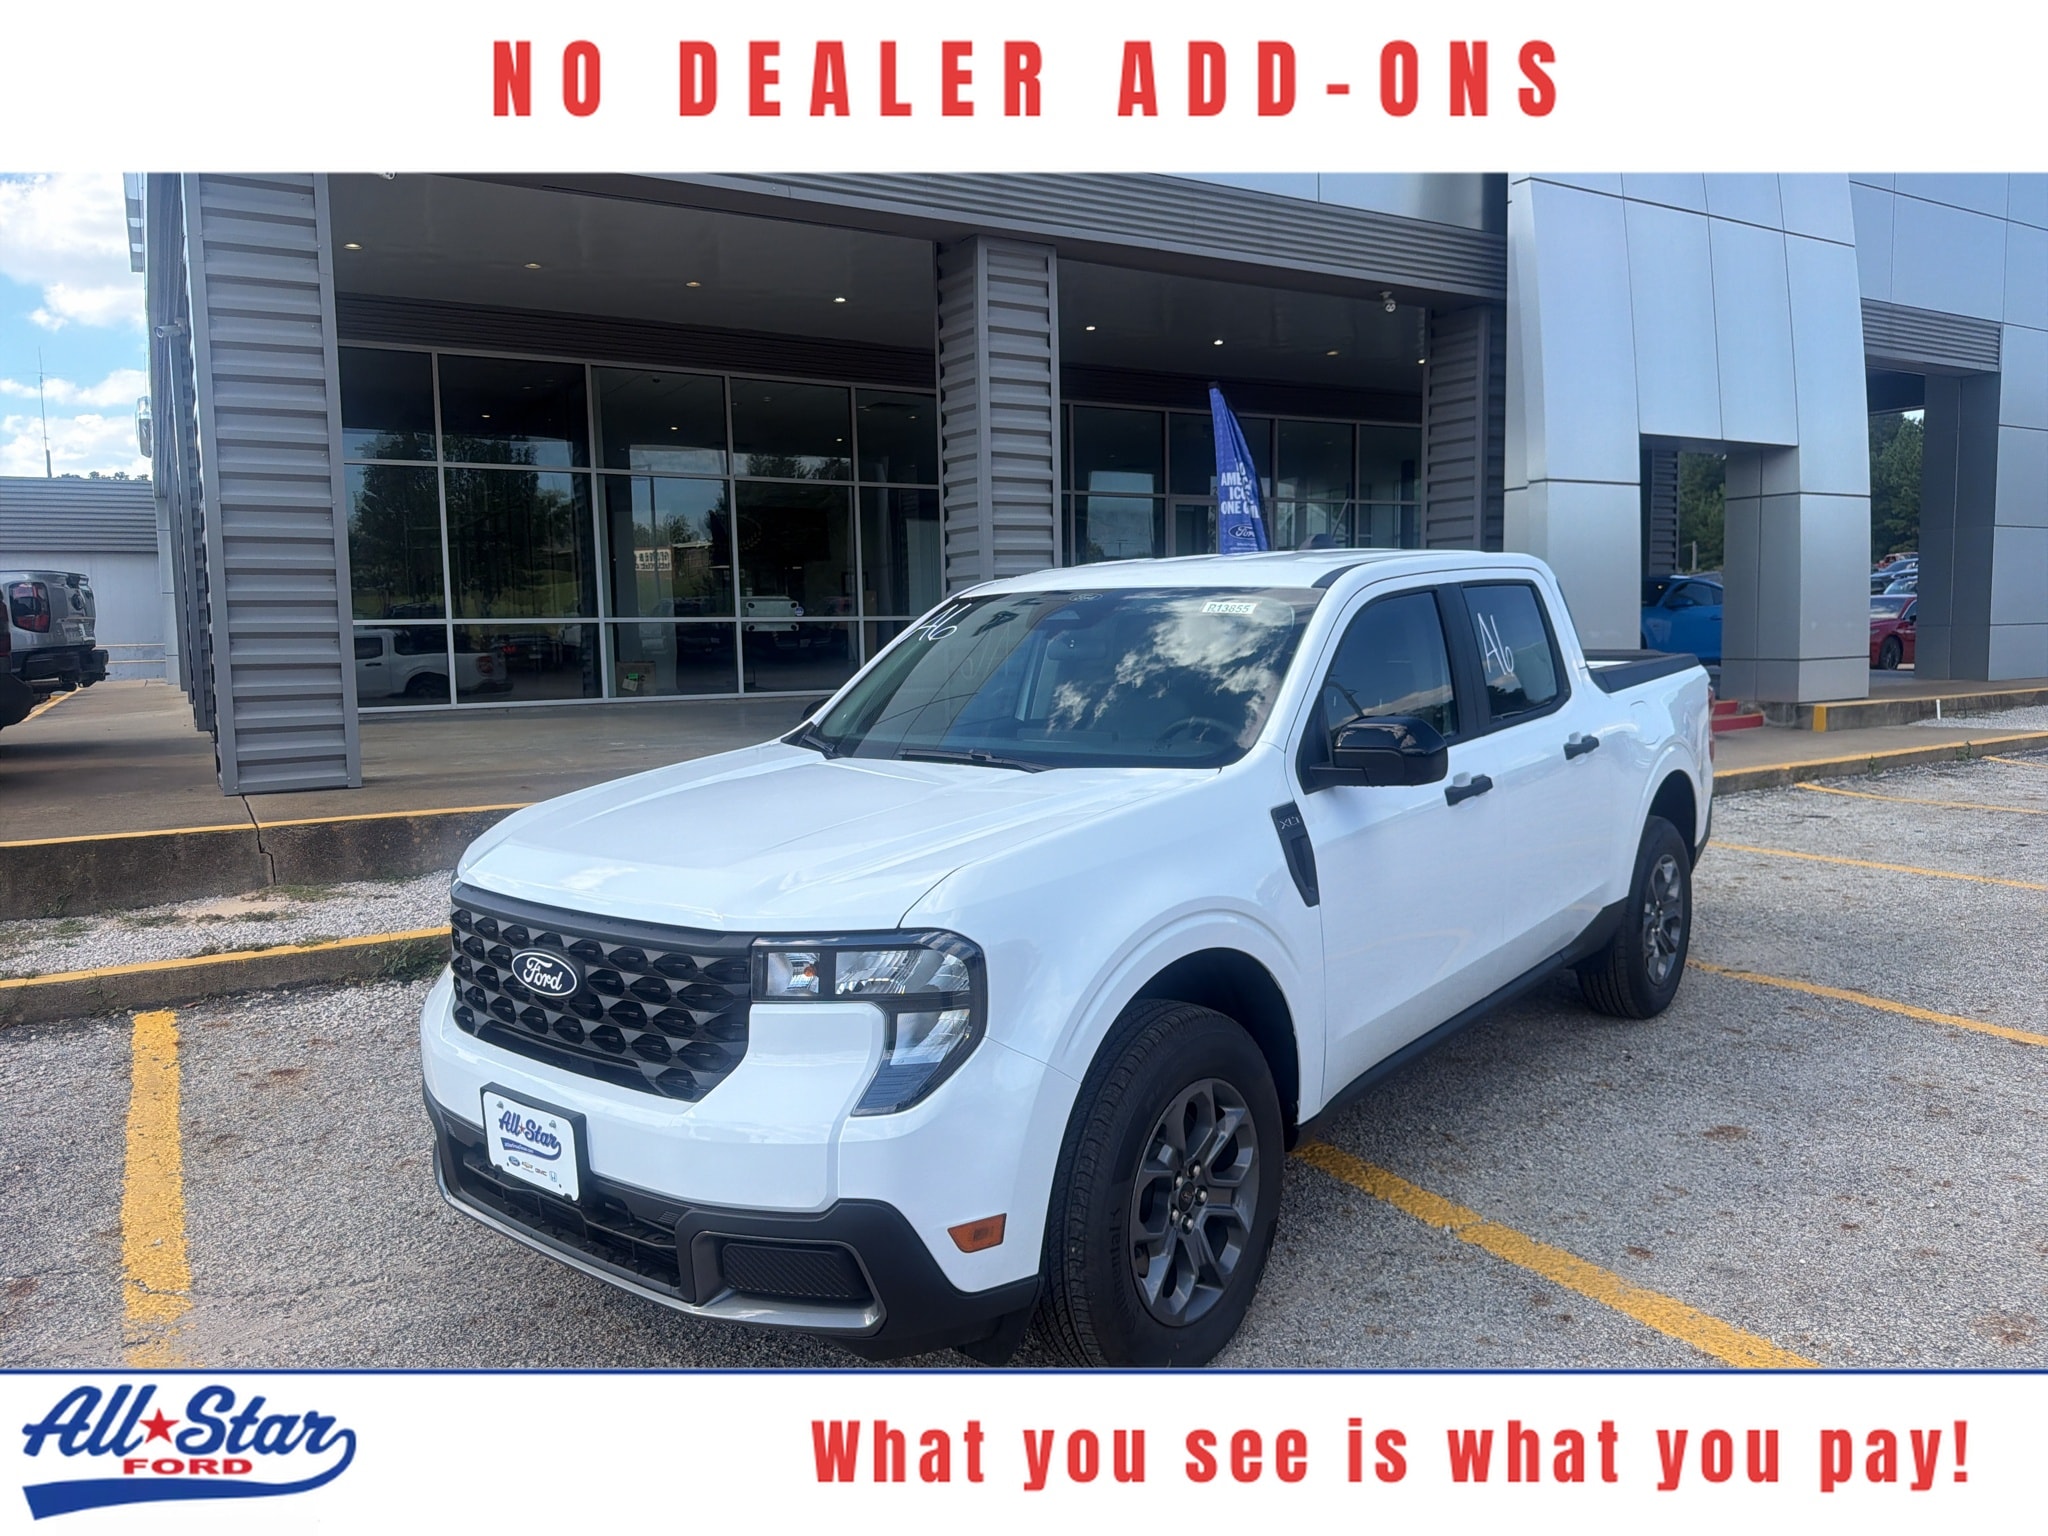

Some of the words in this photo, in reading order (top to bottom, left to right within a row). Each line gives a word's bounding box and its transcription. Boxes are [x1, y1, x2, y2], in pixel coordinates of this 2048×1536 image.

[1221, 501, 1241, 515] ONE
[522, 956, 564, 991] Ford
[498, 1110, 521, 1137] All
[525, 1119, 561, 1150] Star
